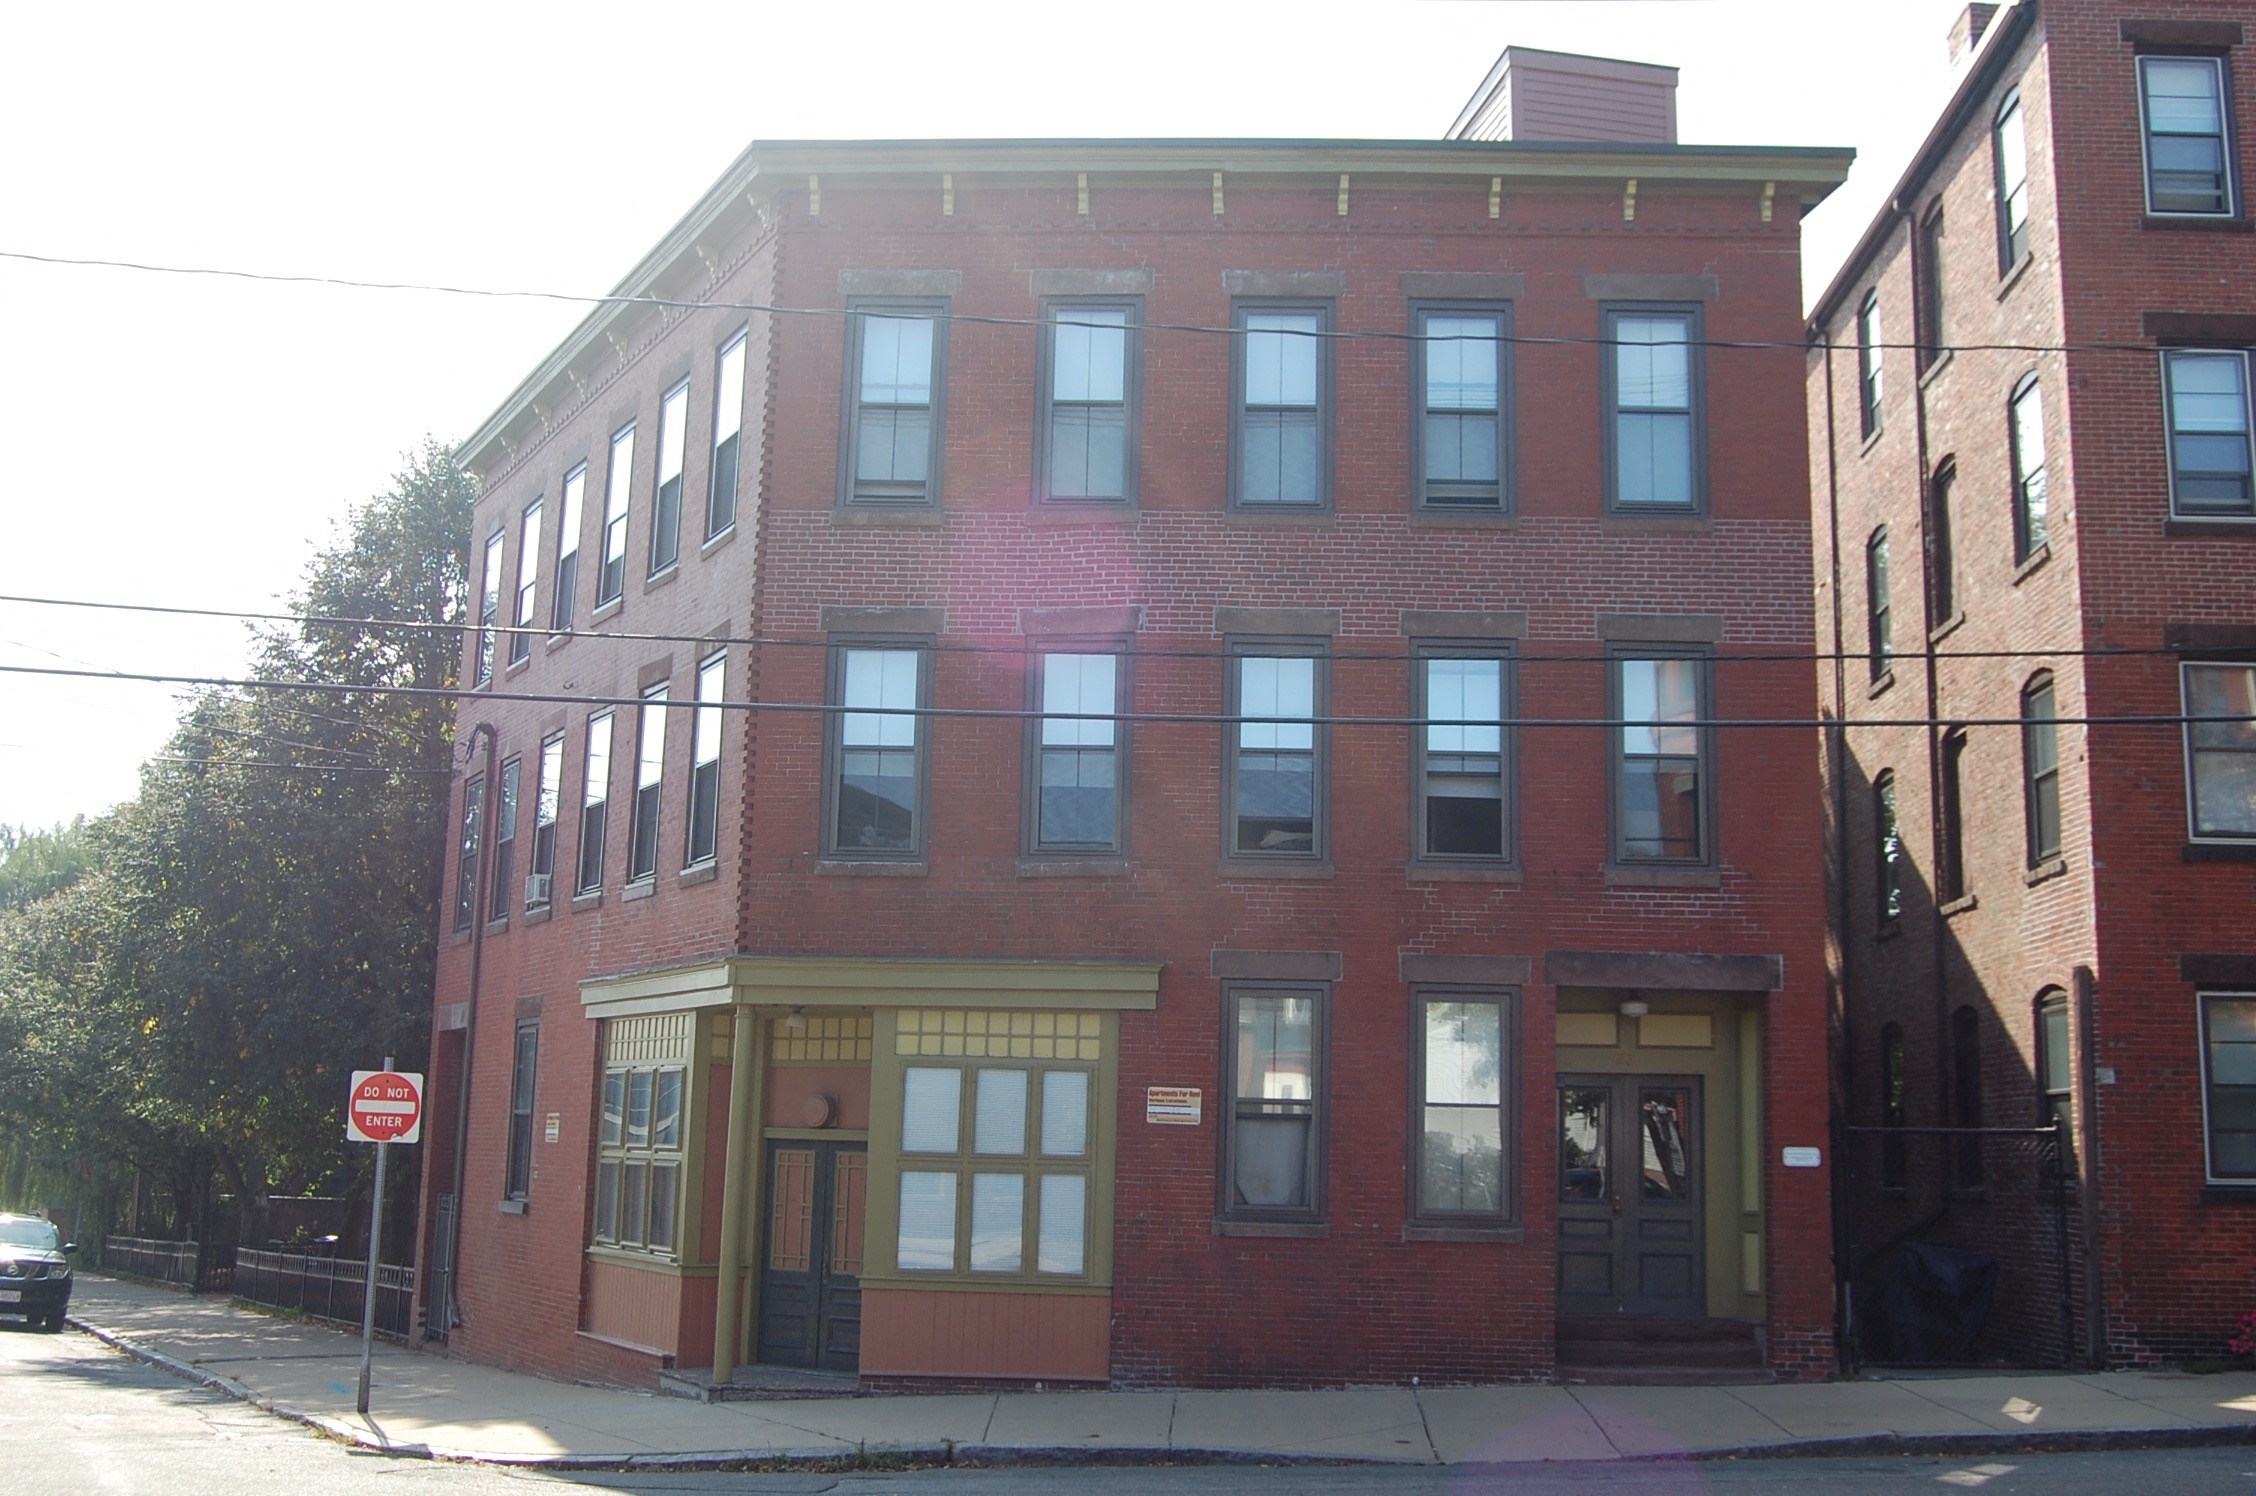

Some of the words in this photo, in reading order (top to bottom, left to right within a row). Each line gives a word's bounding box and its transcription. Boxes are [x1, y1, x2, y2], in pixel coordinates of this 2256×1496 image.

[364, 1086, 380, 1097] DO
[387, 1087, 410, 1099] NOT
[365, 1115, 403, 1127] ENTER
